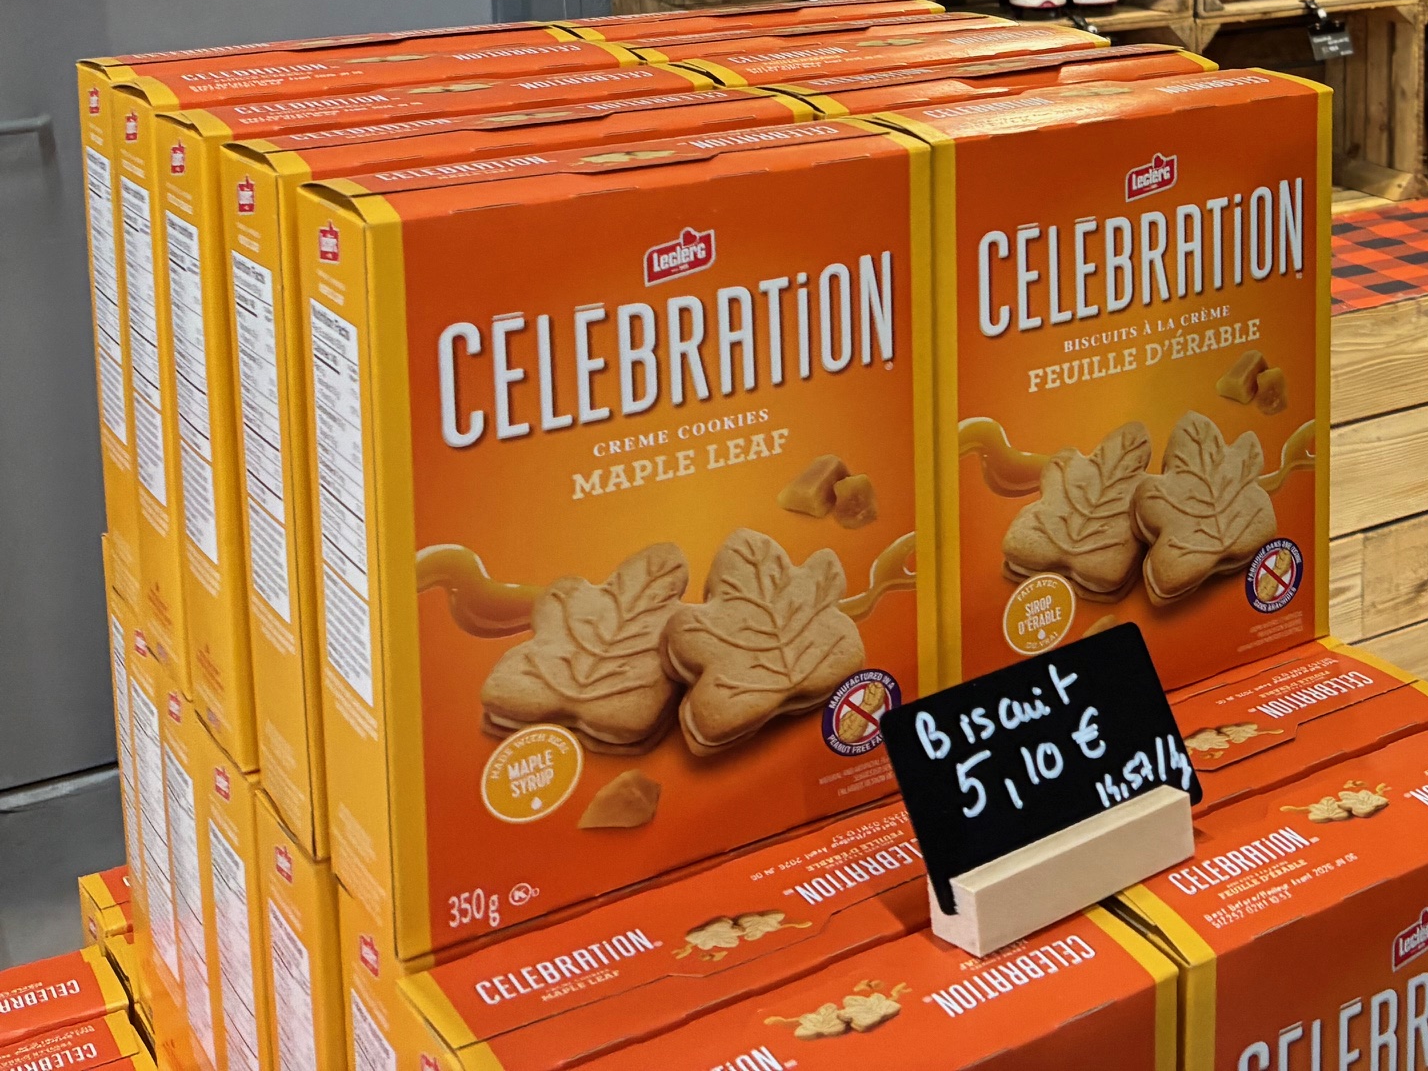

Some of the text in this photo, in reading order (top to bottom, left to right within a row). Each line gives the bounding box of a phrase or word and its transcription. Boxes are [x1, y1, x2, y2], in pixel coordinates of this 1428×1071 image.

[1063, 325, 1138, 353] BISCUITS
[1157, 316, 1175, 332] LA
[1180, 304, 1231, 327] CRÈME
[1027, 347, 1138, 393] FEUILLE
[593, 408, 771, 458] CREME COOKIES
[571, 428, 790, 501] MAPLE LEAF
[1025, 595, 1052, 617] SIROP
[828, 671, 883, 710] MANUFACTURED
[915, 664, 1078, 760] Biscuit
[827, 734, 851, 754] PEANUT
[851, 742, 871, 754] FREE
[956, 750, 1064, 818] 5,10
[1071, 706, 1106, 758] €
[507, 749, 554, 780] MAPLE
[510, 769, 555, 798] SYRUP
[1217, 879, 1261, 900] FEUILLE
[1203, 907, 1228, 923] Best
[541, 969, 620, 1002] MAPLE LEAF
